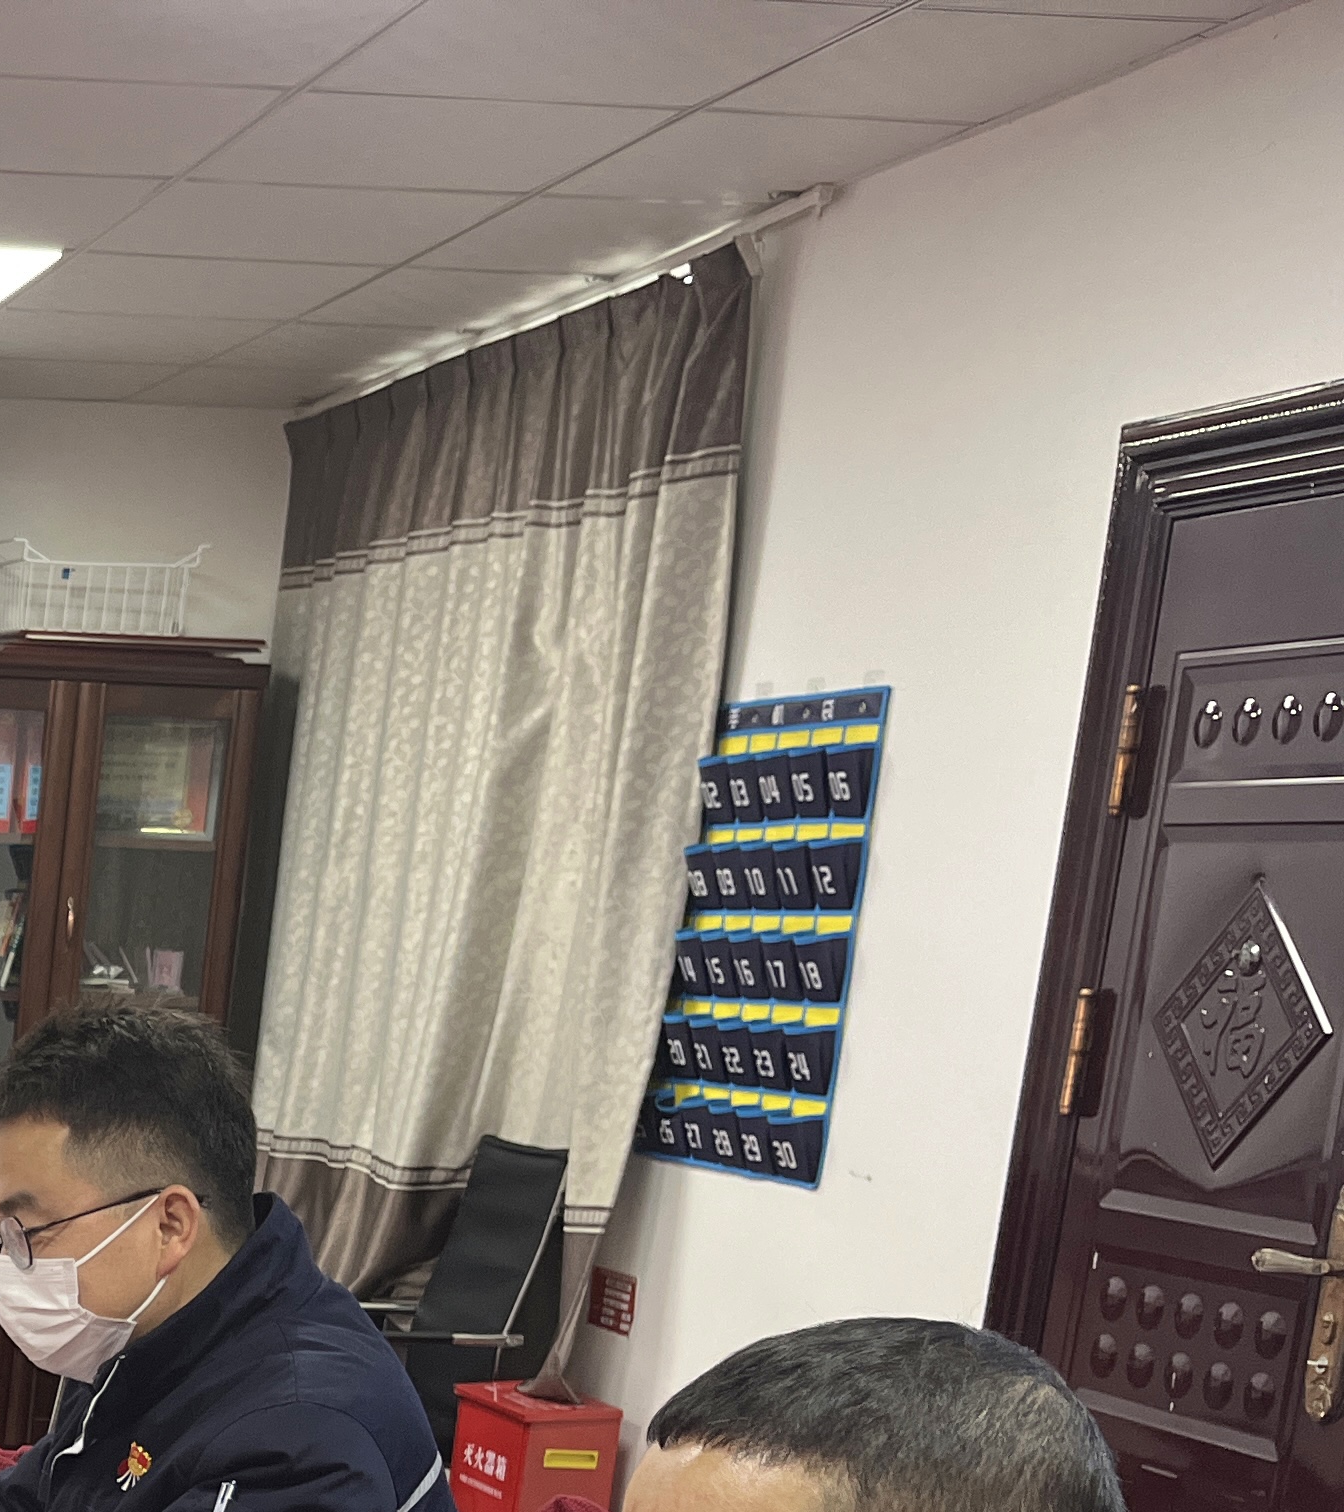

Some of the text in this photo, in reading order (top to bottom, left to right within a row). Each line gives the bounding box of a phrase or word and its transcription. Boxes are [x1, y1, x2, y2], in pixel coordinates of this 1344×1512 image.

[729, 778, 751, 807] 03
[758, 774, 781, 804] 04
[792, 772, 814, 803] 05
[827, 770, 851, 802] 06
[716, 868, 737, 896] 09
[744, 868, 766, 896] 10
[776, 866, 797, 896] 11
[812, 865, 836, 895] 12
[678, 955, 823, 991] 14 15 16 17 18
[667, 1038, 810, 1082] 20 21 22 23 24
[659, 1117, 676, 1145] 26
[684, 1121, 703, 1150] 27
[712, 1127, 734, 1157] 28
[741, 1132, 763, 1163] 29
[772, 1139, 797, 1170] 30
[463, 1442, 508, 1482] 灭火器箱
